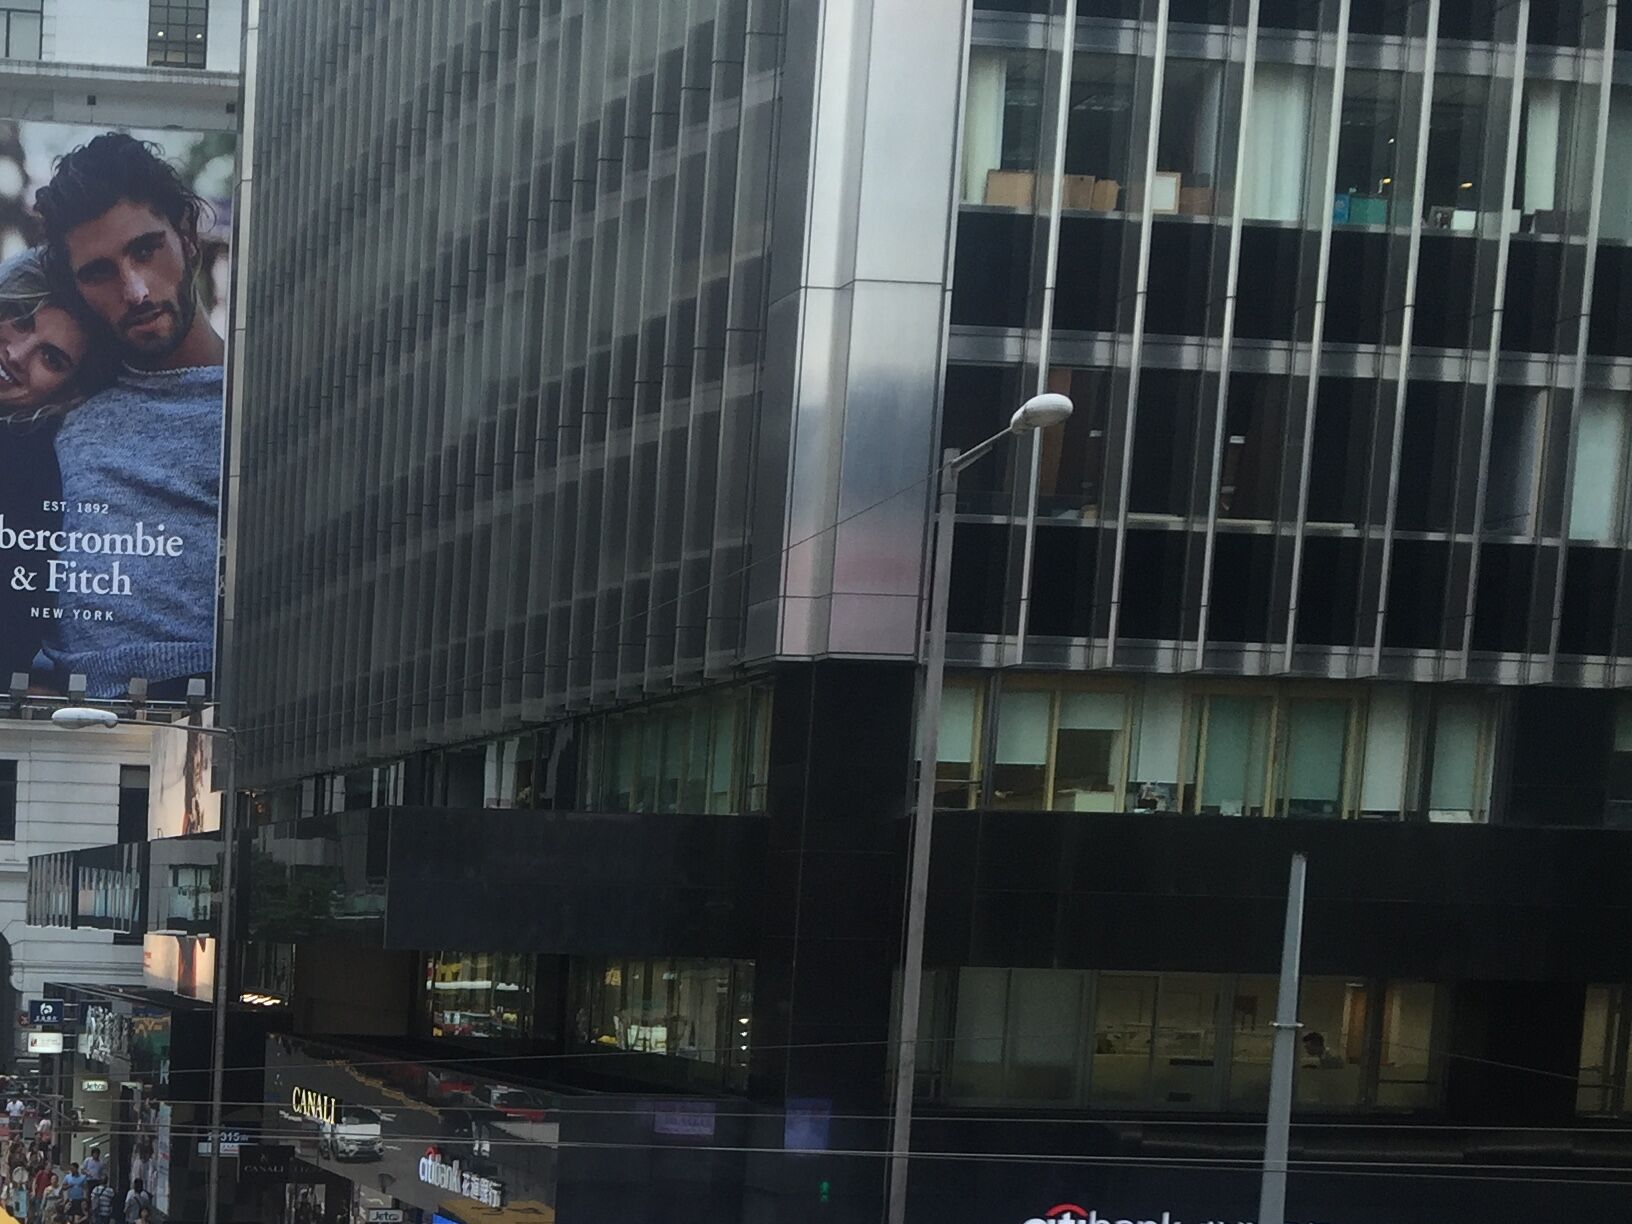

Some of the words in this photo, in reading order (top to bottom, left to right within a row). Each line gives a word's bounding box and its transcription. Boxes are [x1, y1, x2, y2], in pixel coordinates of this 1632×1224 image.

[44, 501, 69, 512] EST.
[77, 502, 109, 514] 1892
[11, 565, 37, 591] &
[46, 560, 132, 595] Fitch
[30, 607, 63, 619] NEW
[73, 609, 114, 621] YORK
[292, 1087, 336, 1124] CANALI
[244, 1165, 284, 1173] CANALI
[419, 1152, 461, 1193] citibank
[372, 1208, 399, 1221] Jetco
